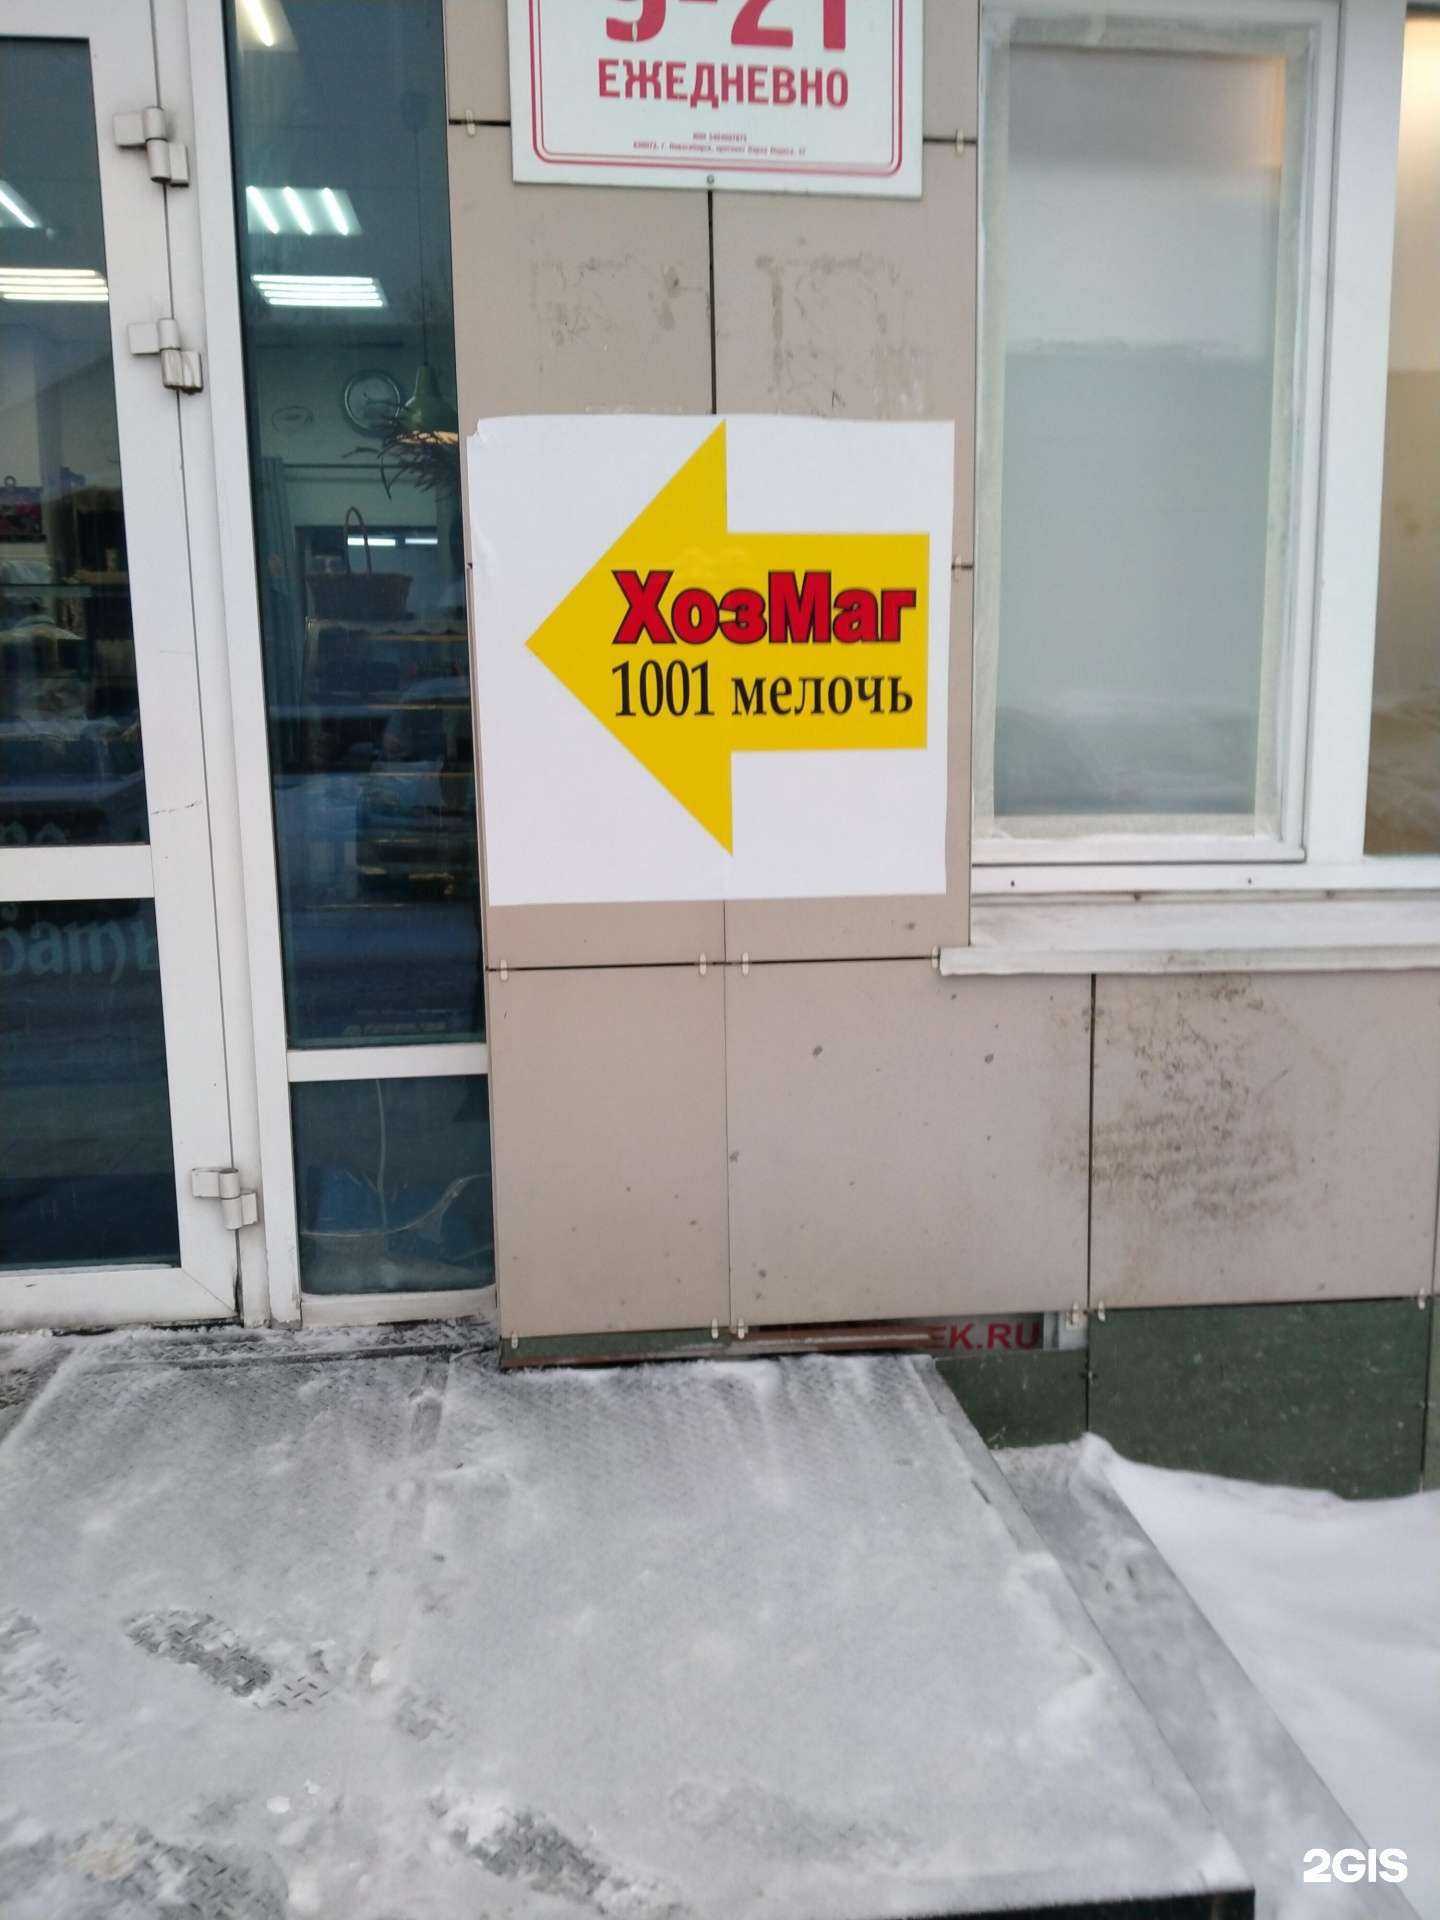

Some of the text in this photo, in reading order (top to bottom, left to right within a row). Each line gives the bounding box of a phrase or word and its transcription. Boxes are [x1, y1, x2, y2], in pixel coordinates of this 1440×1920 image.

[598, 57, 848, 108] ЕЖЕДНЕВНО
[611, 569, 917, 645] ХозМаг
[611, 659, 913, 717] 1001 мелочь
